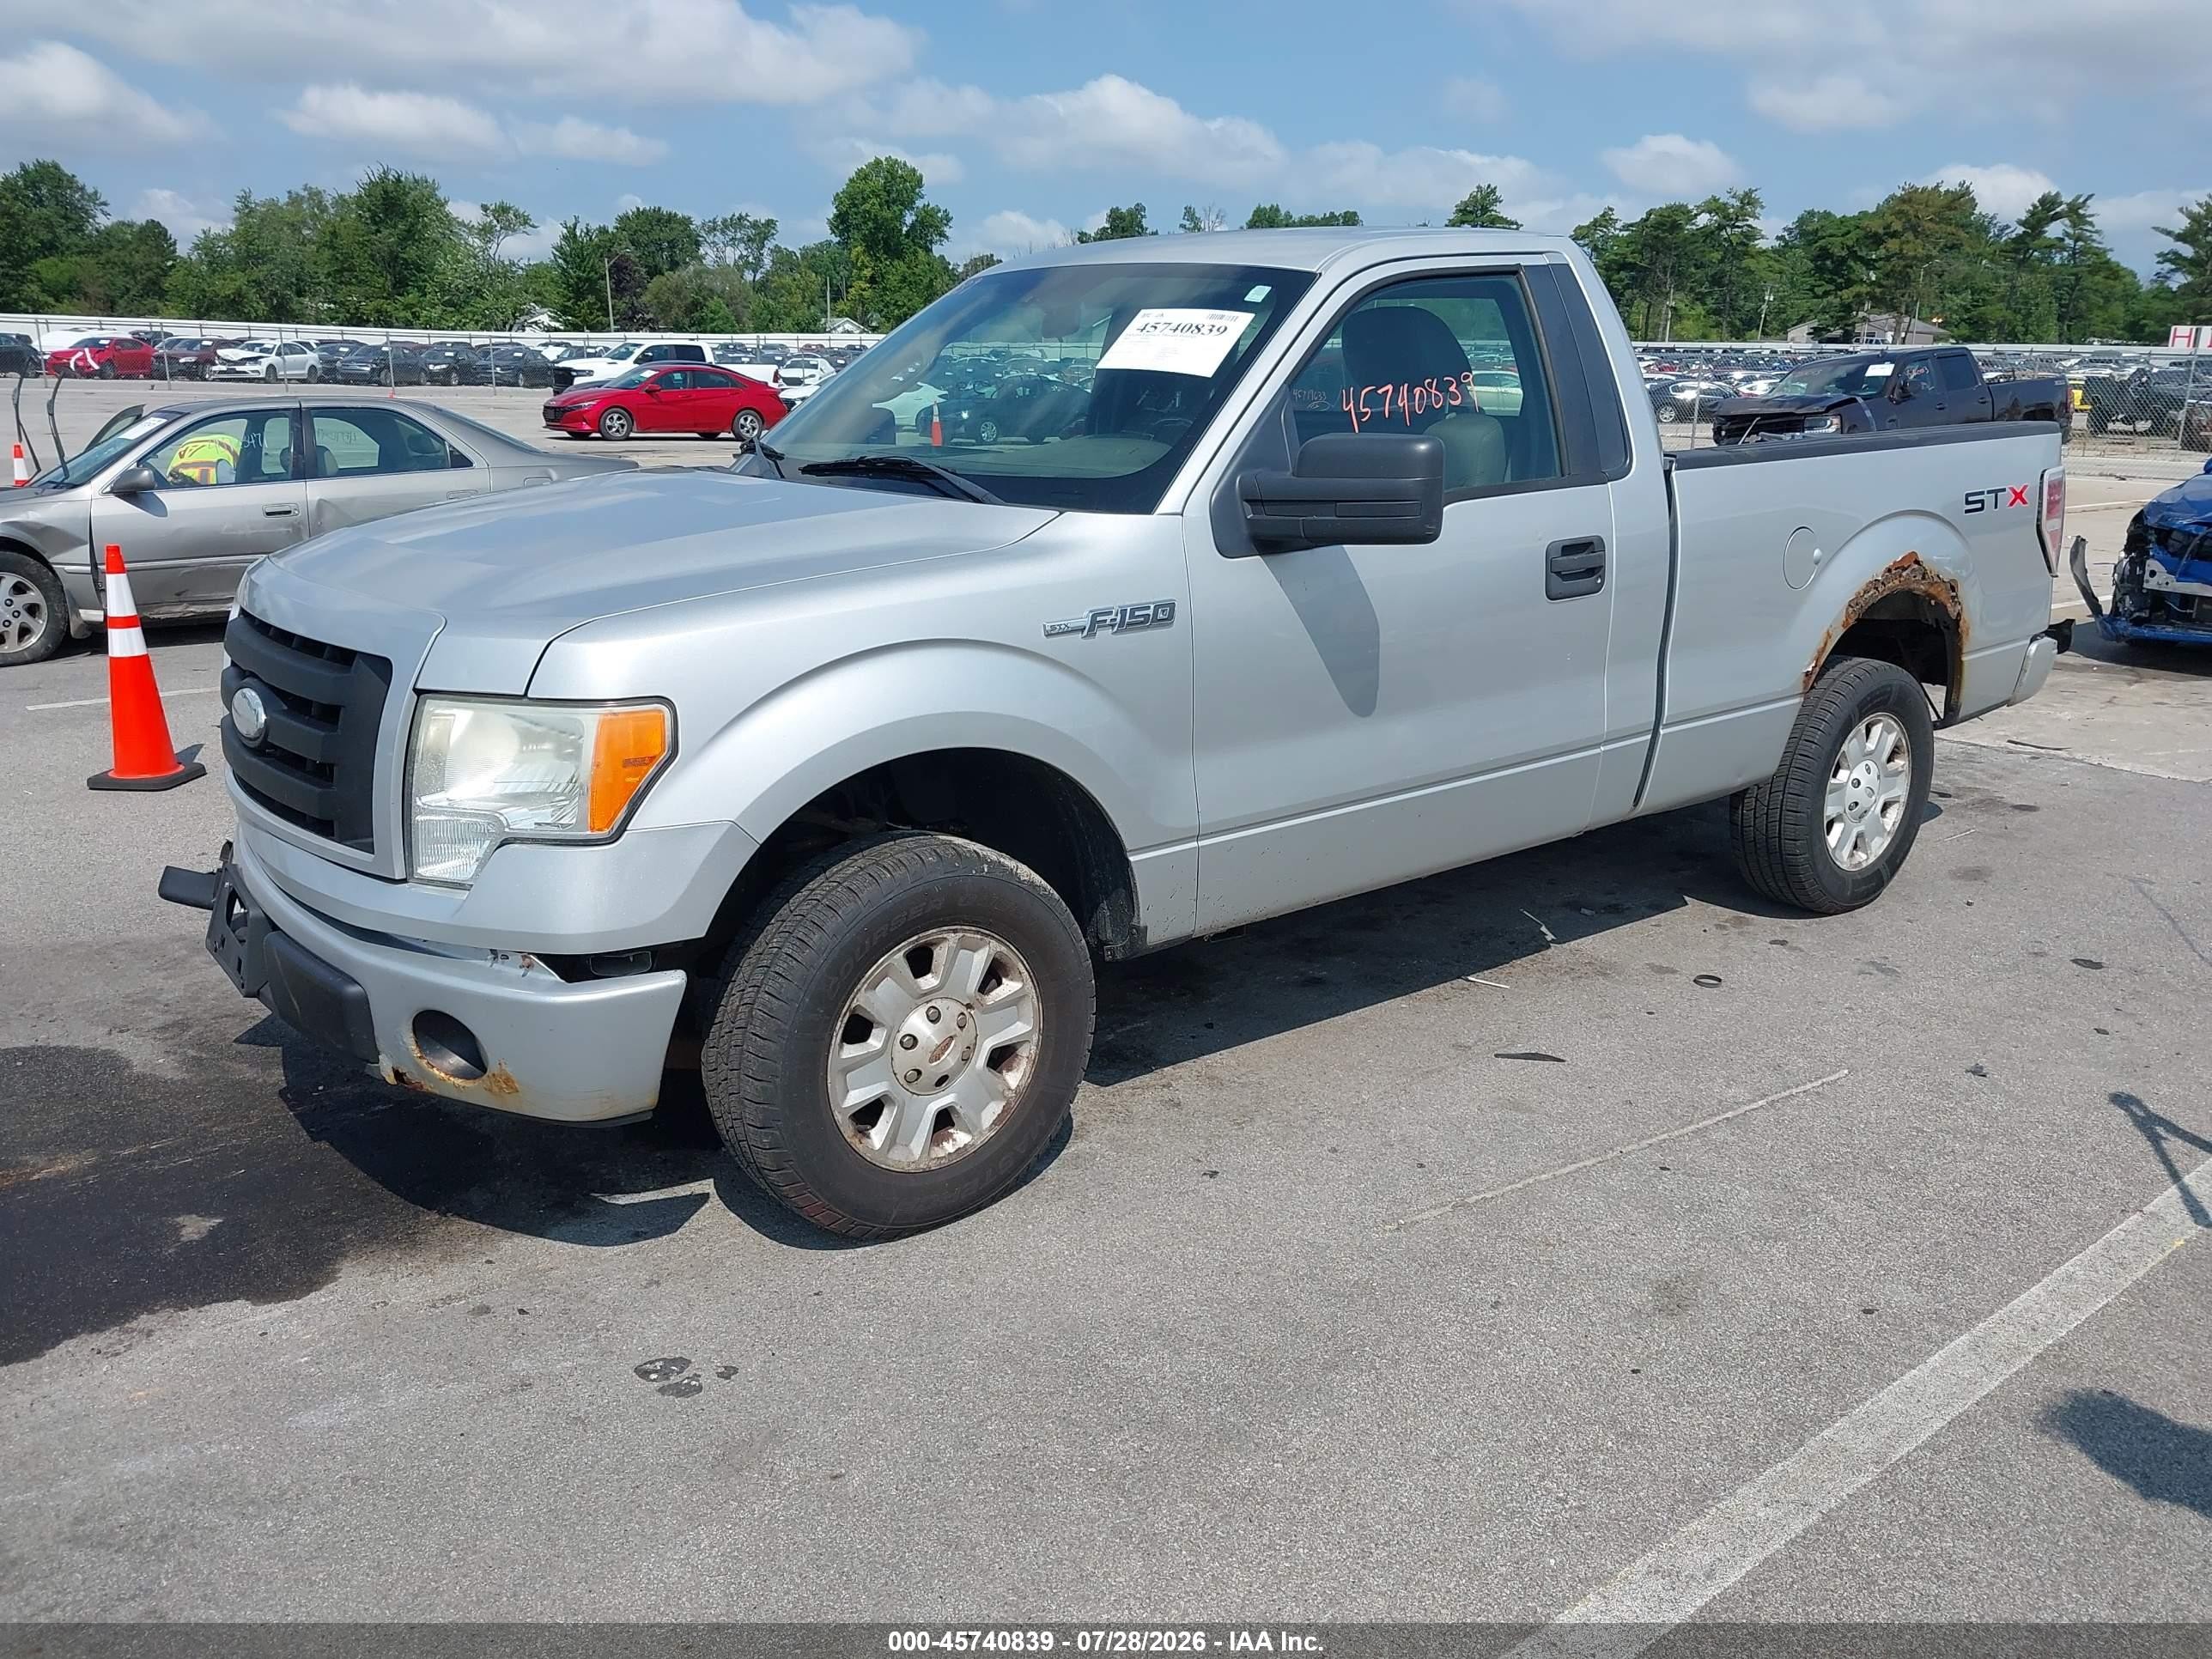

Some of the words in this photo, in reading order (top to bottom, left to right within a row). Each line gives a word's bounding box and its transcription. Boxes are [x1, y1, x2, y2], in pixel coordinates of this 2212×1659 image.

[1136, 322, 1228, 337] 45740839
[1341, 371, 1479, 434] 45740839
[1964, 484, 2029, 514] STX
[1081, 600, 1177, 639] F-150
